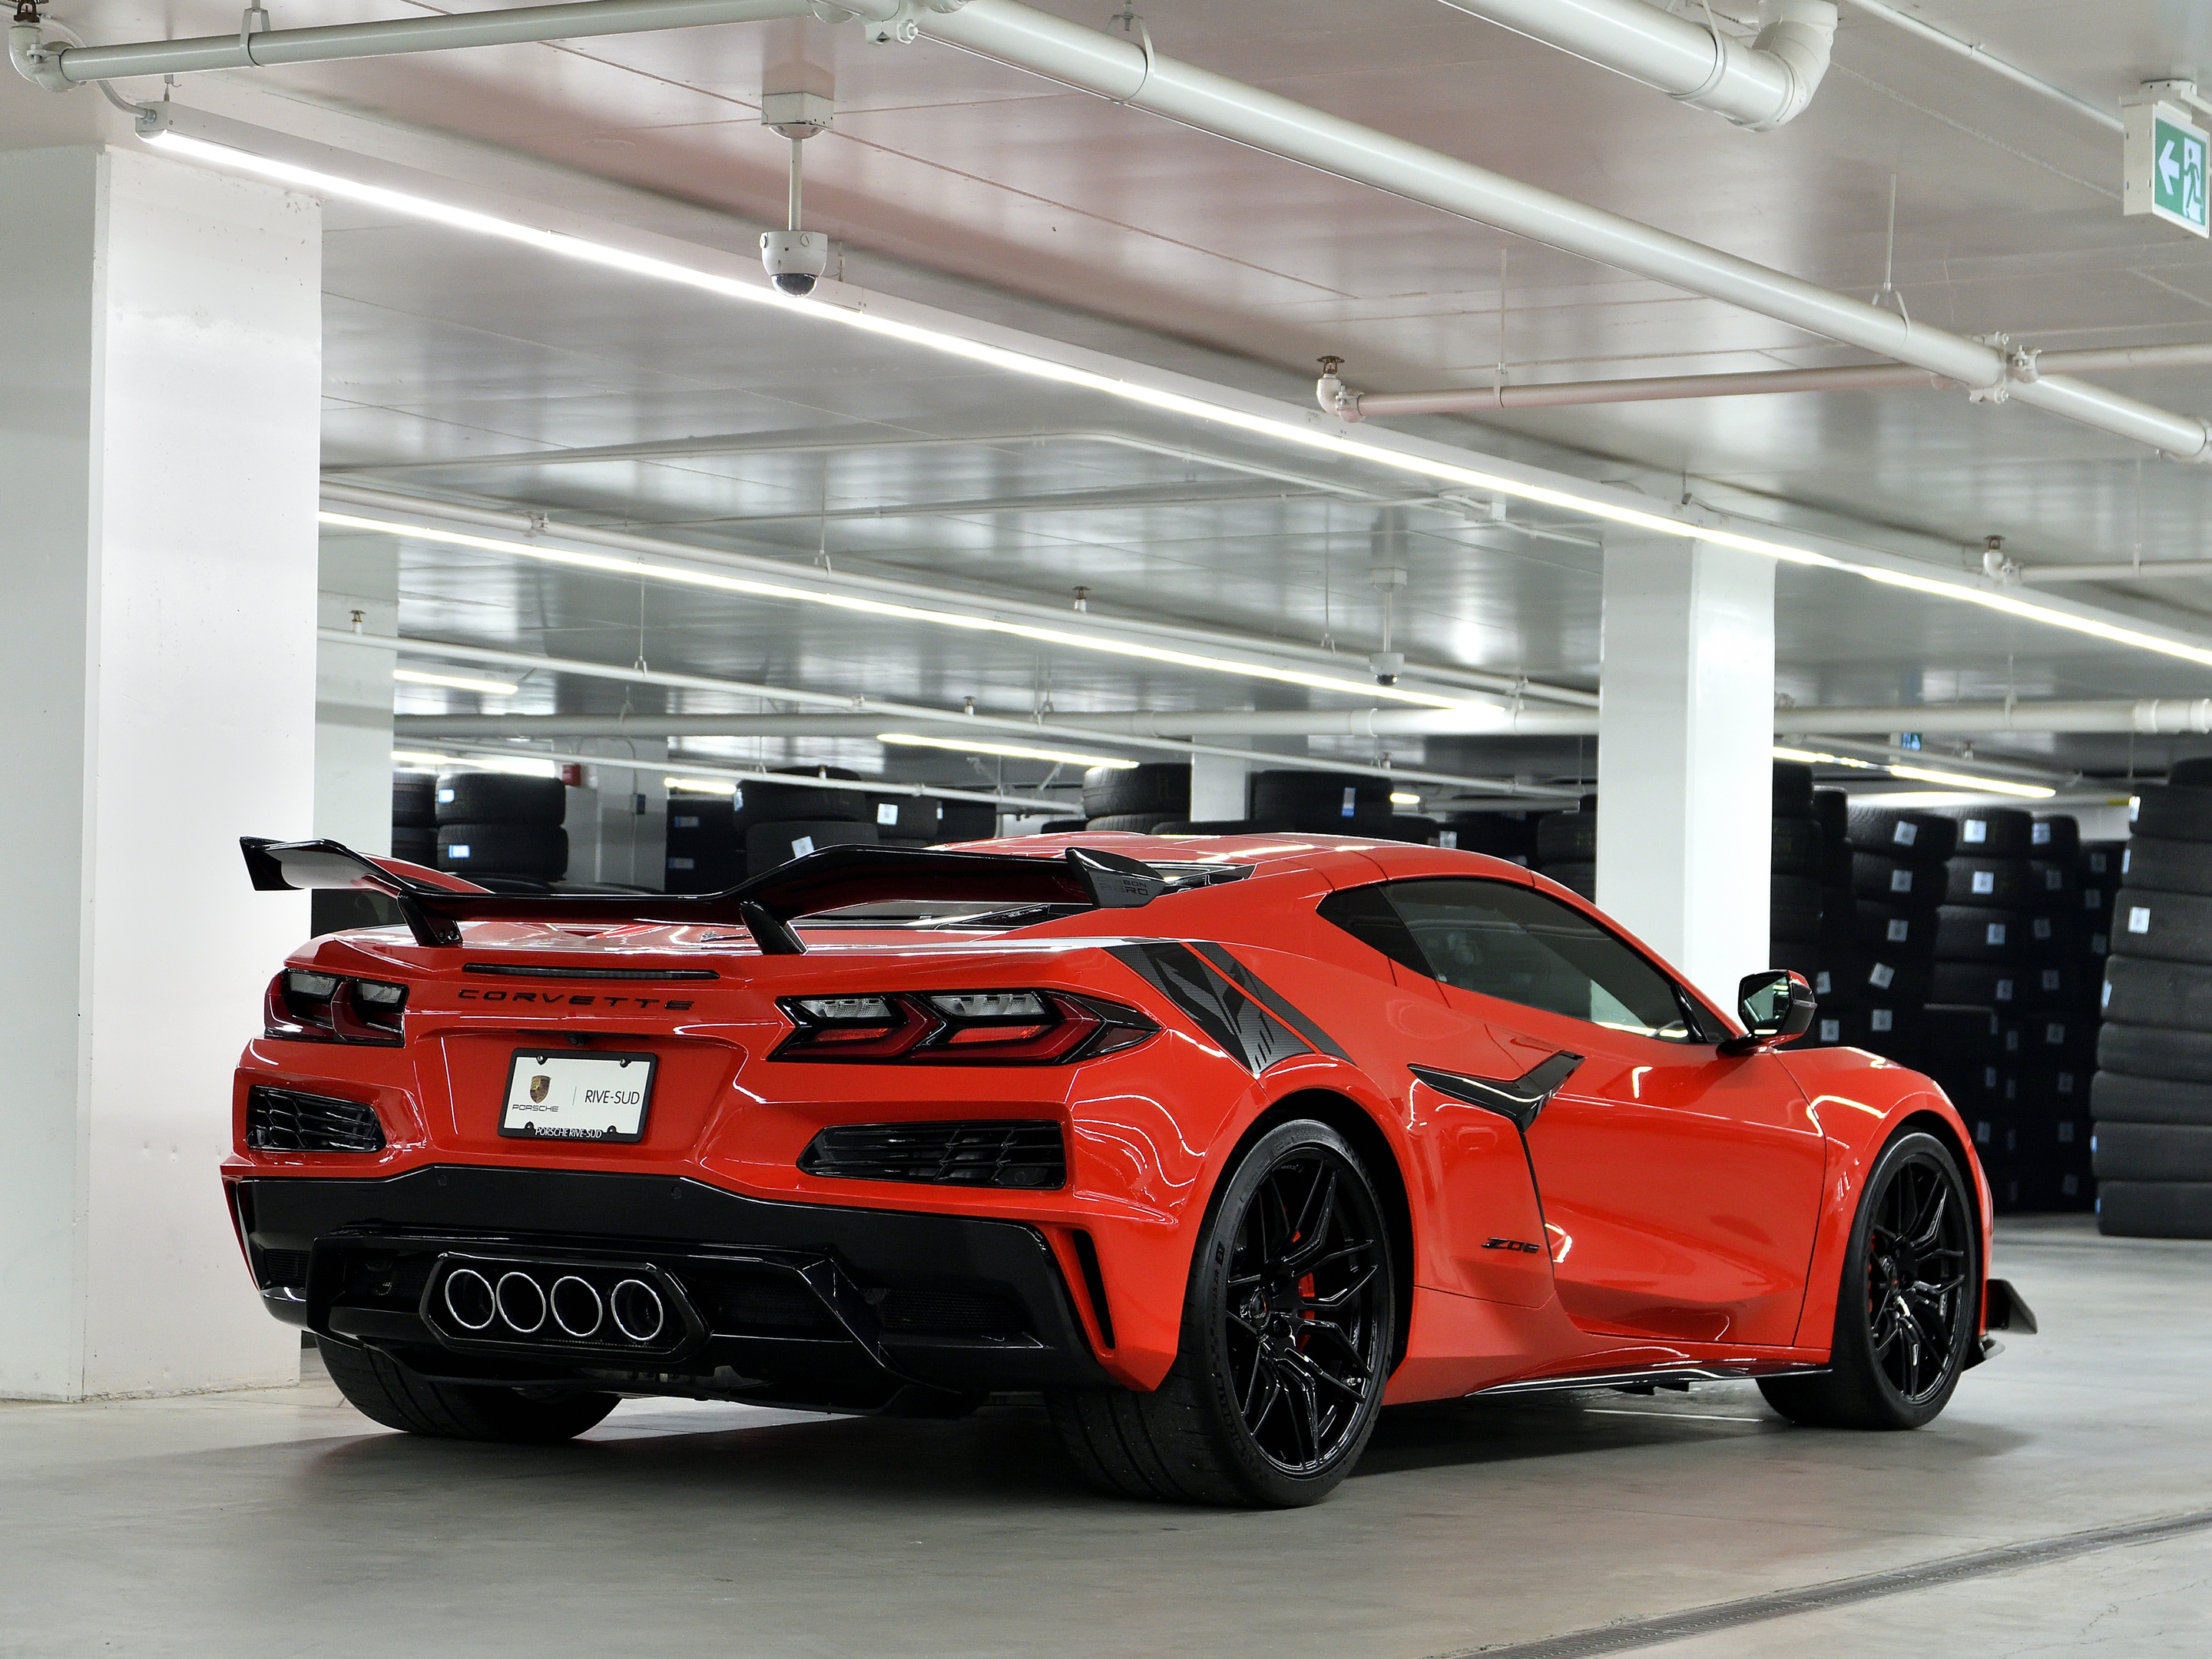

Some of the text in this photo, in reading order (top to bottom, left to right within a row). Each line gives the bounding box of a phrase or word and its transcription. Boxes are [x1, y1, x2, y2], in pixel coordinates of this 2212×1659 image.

[1096, 876, 1147, 888] CBON
[458, 988, 694, 1011] CORVETTE
[584, 1089, 641, 1104] RIVE-SUD
[512, 1104, 559, 1112] PORSCHE
[535, 1127, 602, 1138] PORSCHE RIVE-SUD
[1481, 1237, 1541, 1253] Z06
